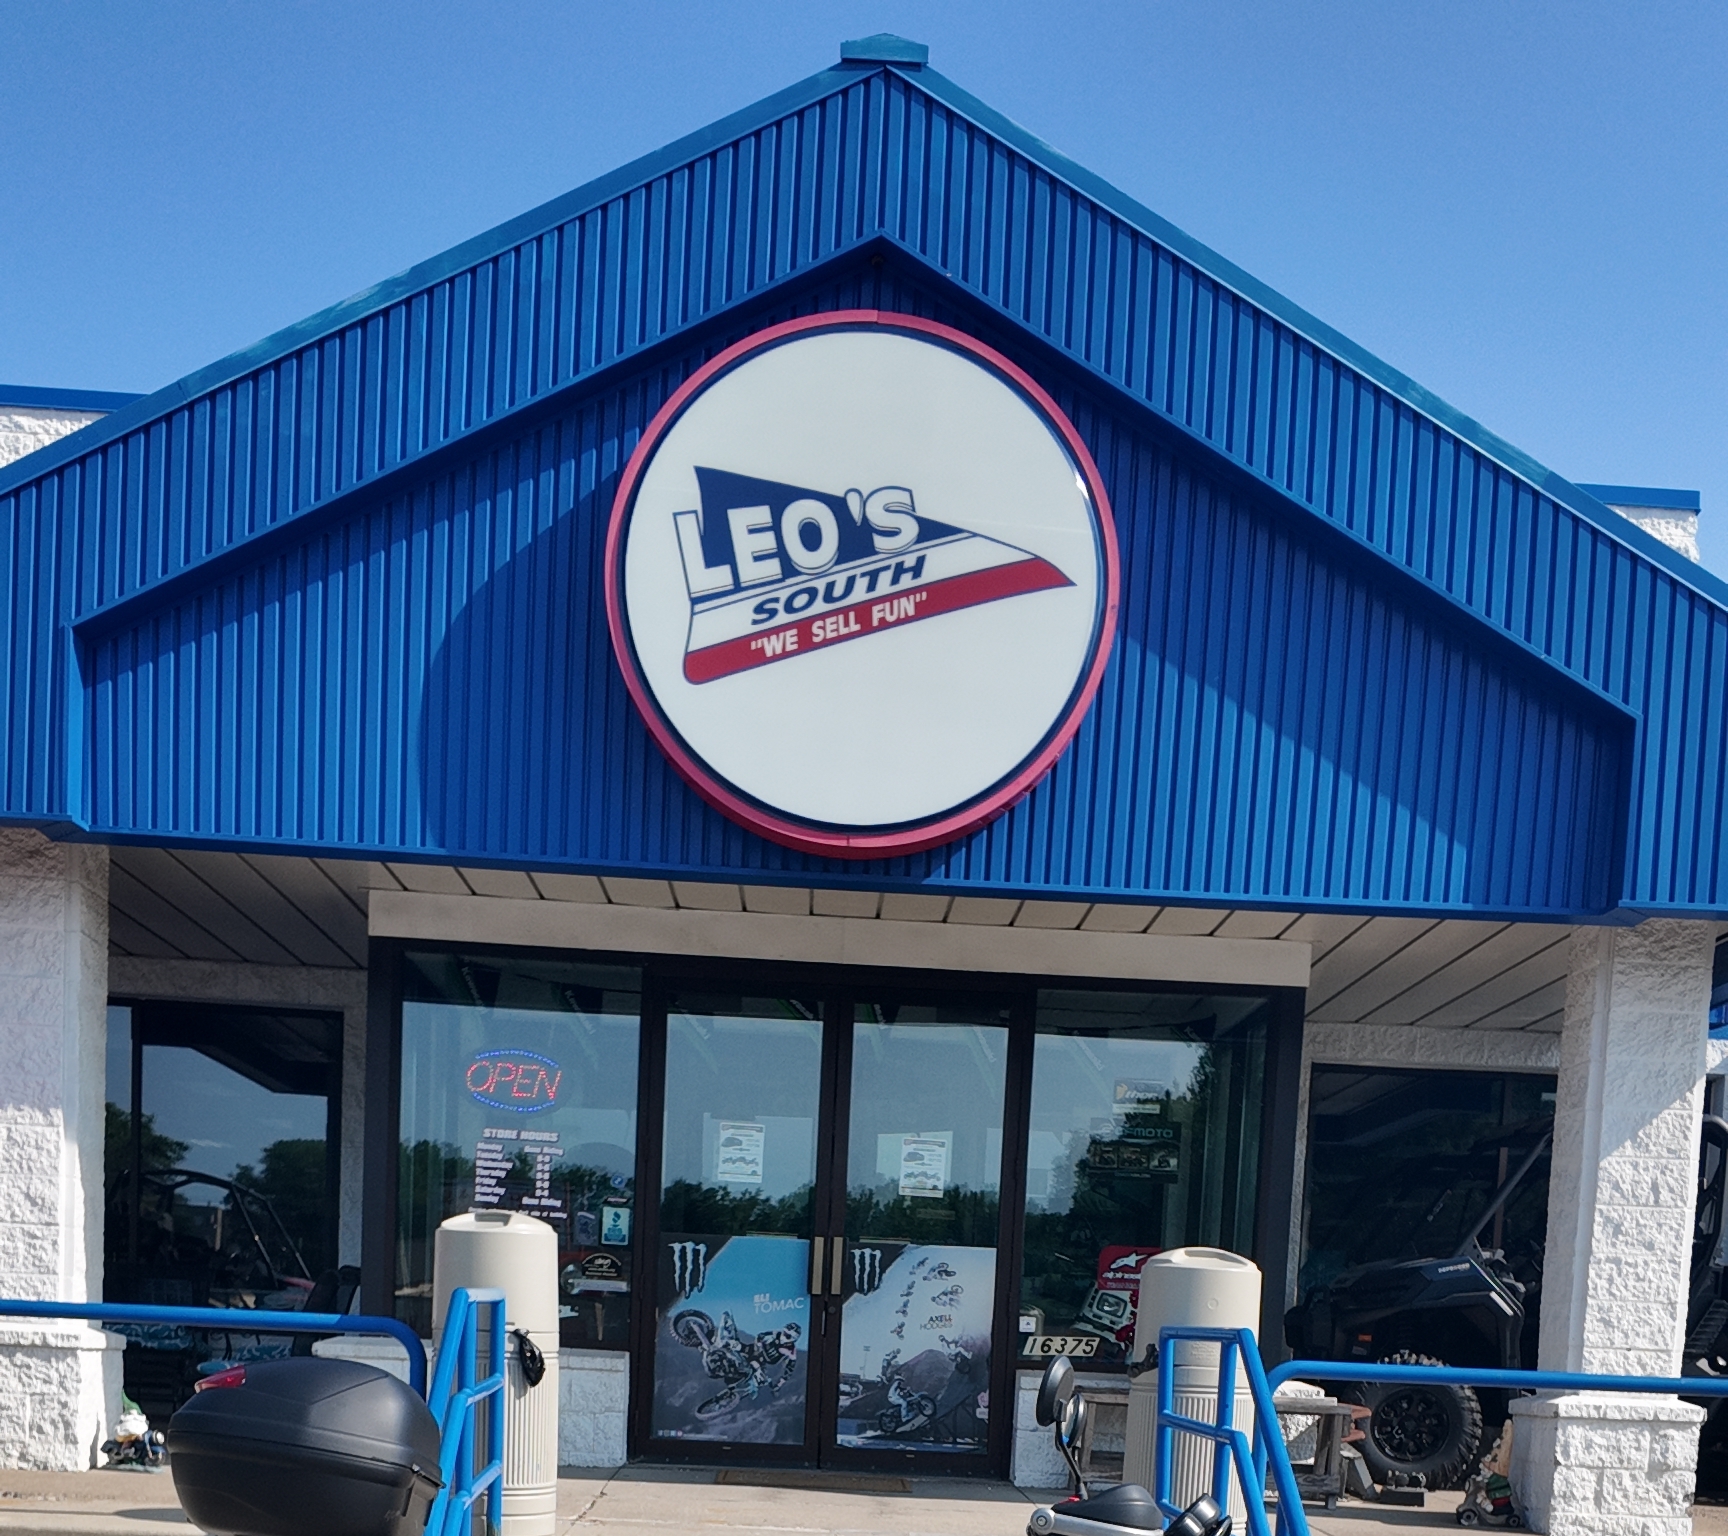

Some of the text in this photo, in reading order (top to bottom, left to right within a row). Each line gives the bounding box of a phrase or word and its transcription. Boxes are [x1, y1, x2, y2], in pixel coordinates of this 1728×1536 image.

[672, 486, 920, 600] LEO'S
[750, 555, 927, 626] SOUTH
[750, 592, 928, 658] "WE SELL FUN"
[465, 1059, 563, 1101] OPEN
[483, 1128, 559, 1142] STORE HOURS
[754, 1297, 805, 1314] TOMAC
[1029, 1337, 1097, 1355] 16375
